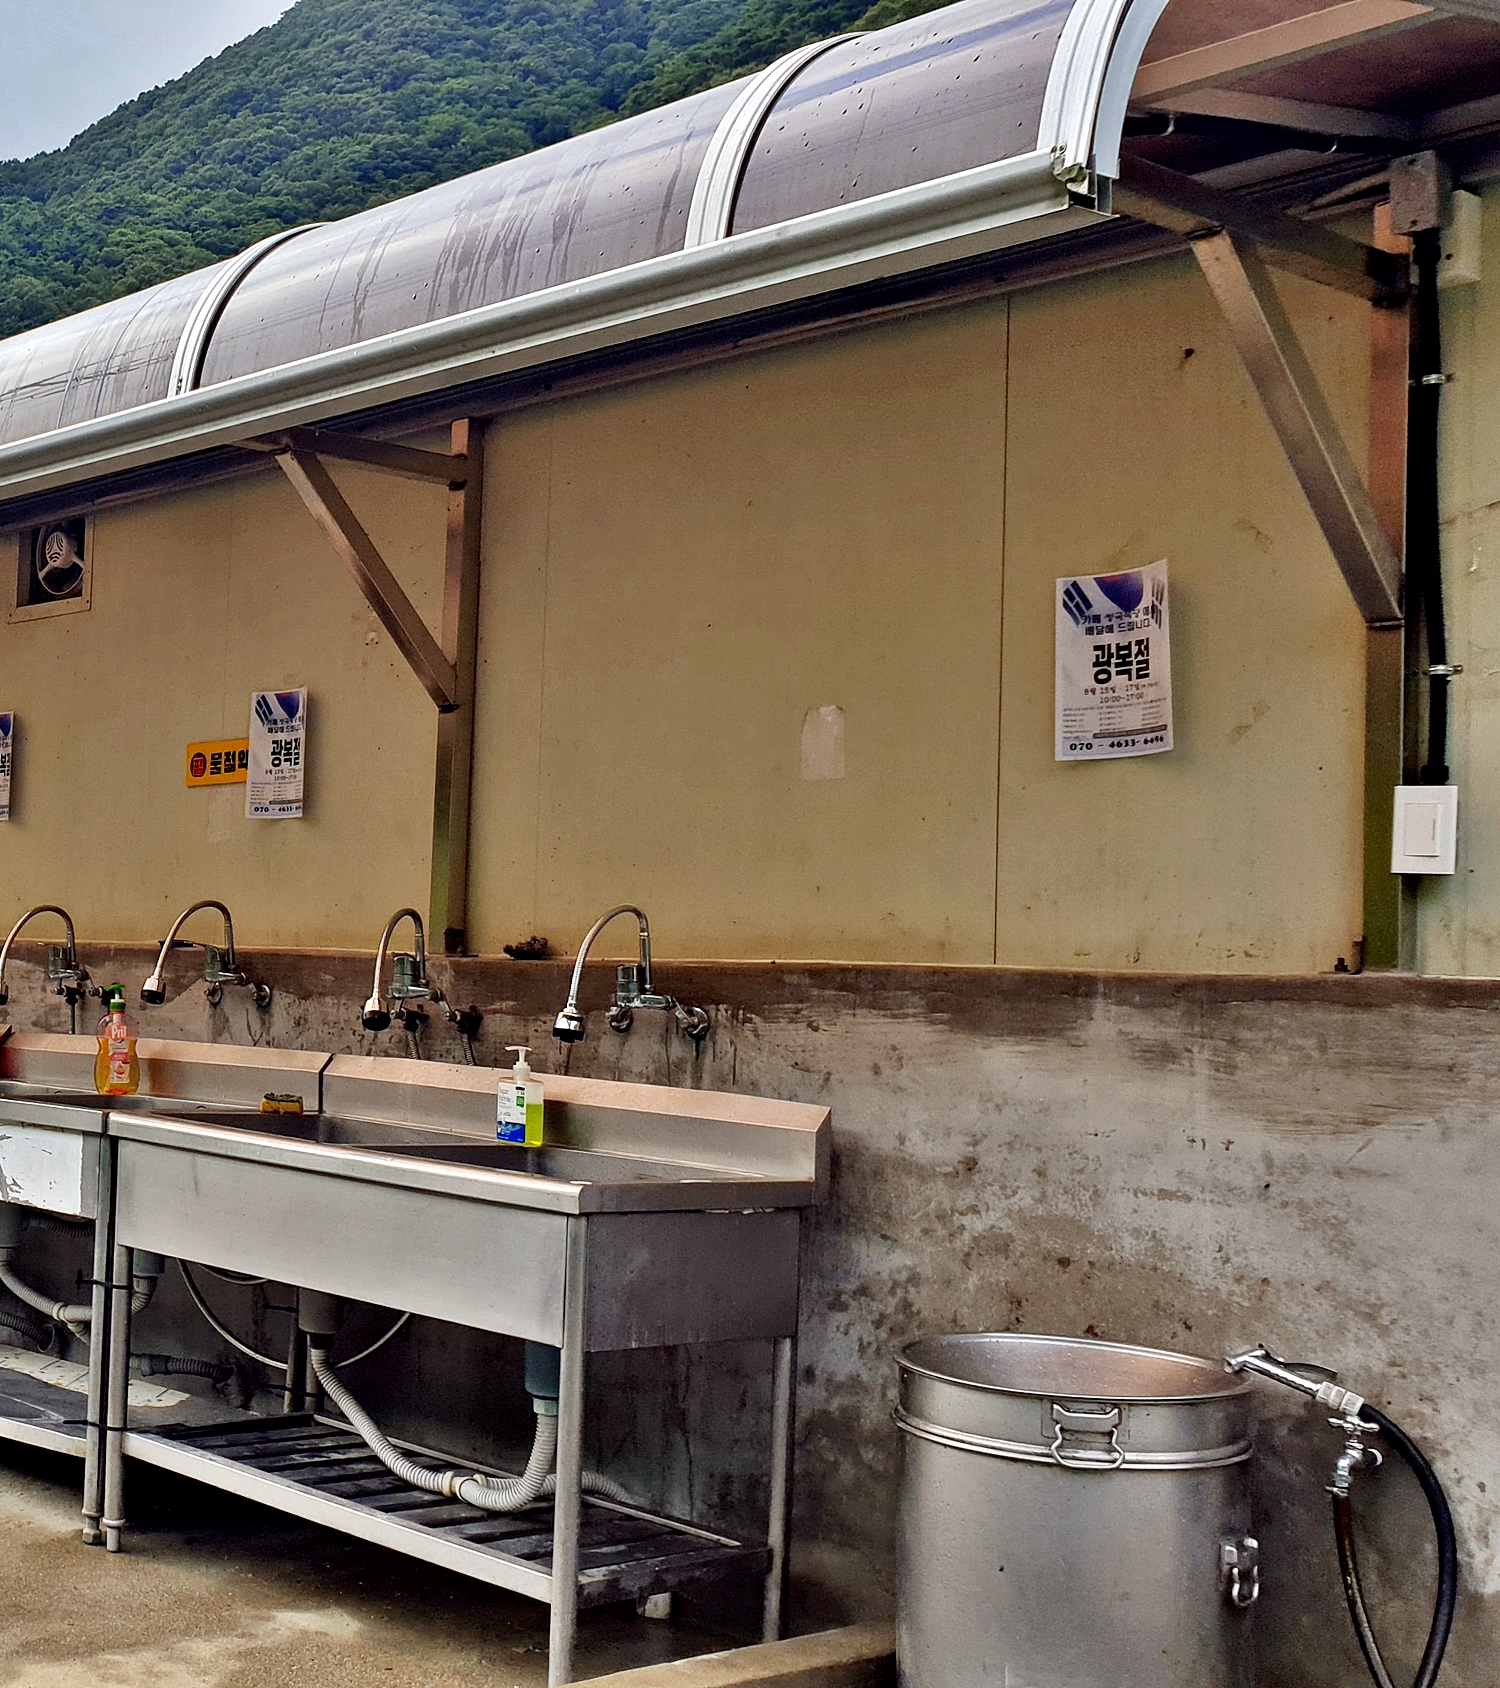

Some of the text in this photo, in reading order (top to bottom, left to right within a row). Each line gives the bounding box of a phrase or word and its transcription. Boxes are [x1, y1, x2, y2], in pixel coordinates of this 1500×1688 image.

[1092, 637, 1150, 685] 광복절
[1069, 742, 1093, 751] 070
[111, 1025, 127, 1040] Pril
